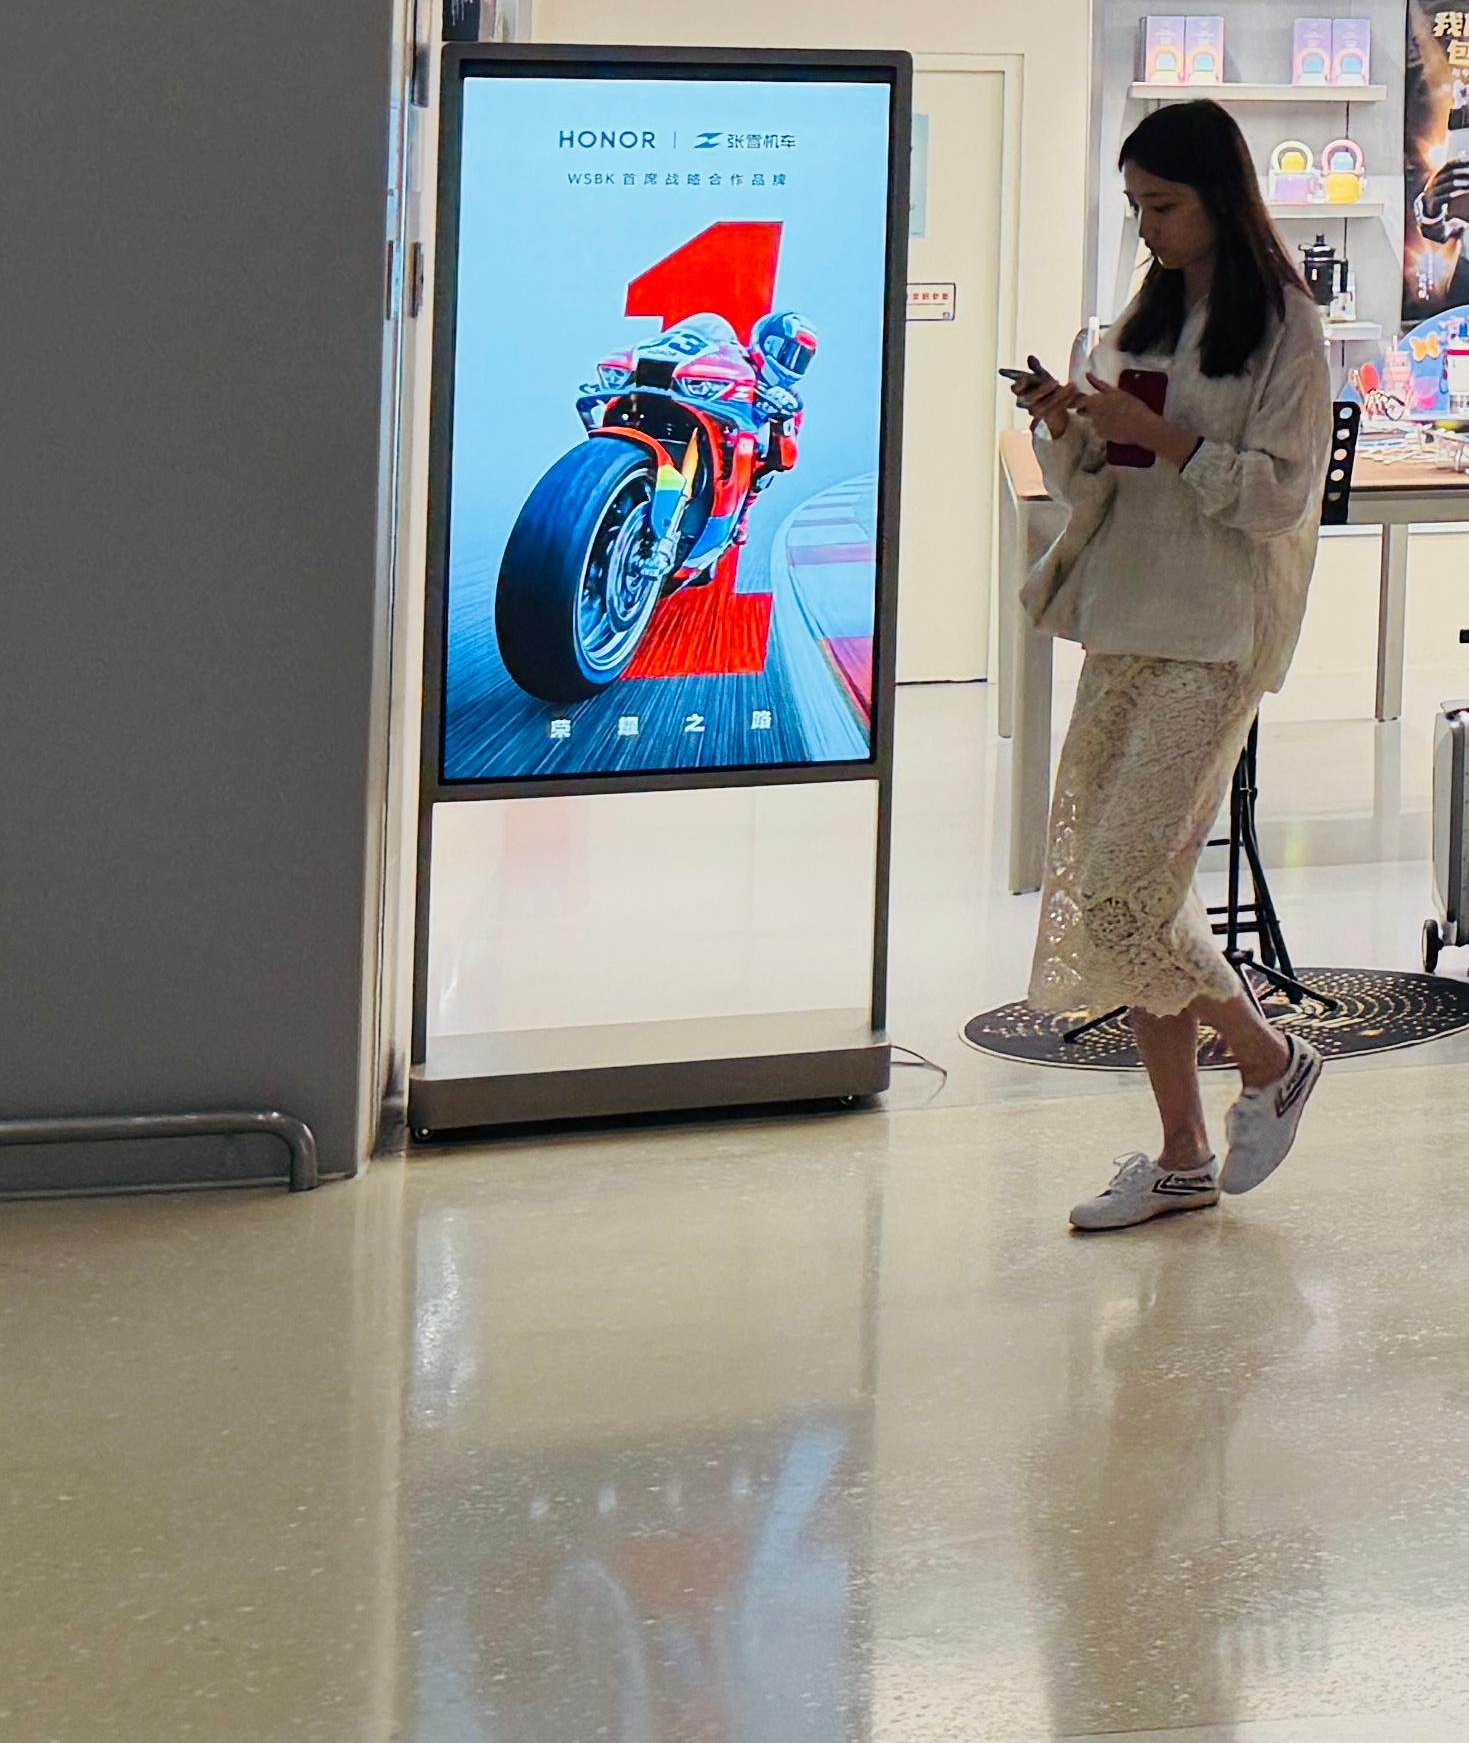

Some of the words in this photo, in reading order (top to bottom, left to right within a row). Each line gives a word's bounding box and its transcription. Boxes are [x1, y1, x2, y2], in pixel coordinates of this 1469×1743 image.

[559, 130, 656, 149] HONOR
[727, 134, 797, 149] 张雪机车
[567, 173, 616, 186] WSBK
[550, 710, 773, 739] 荣耀之路
